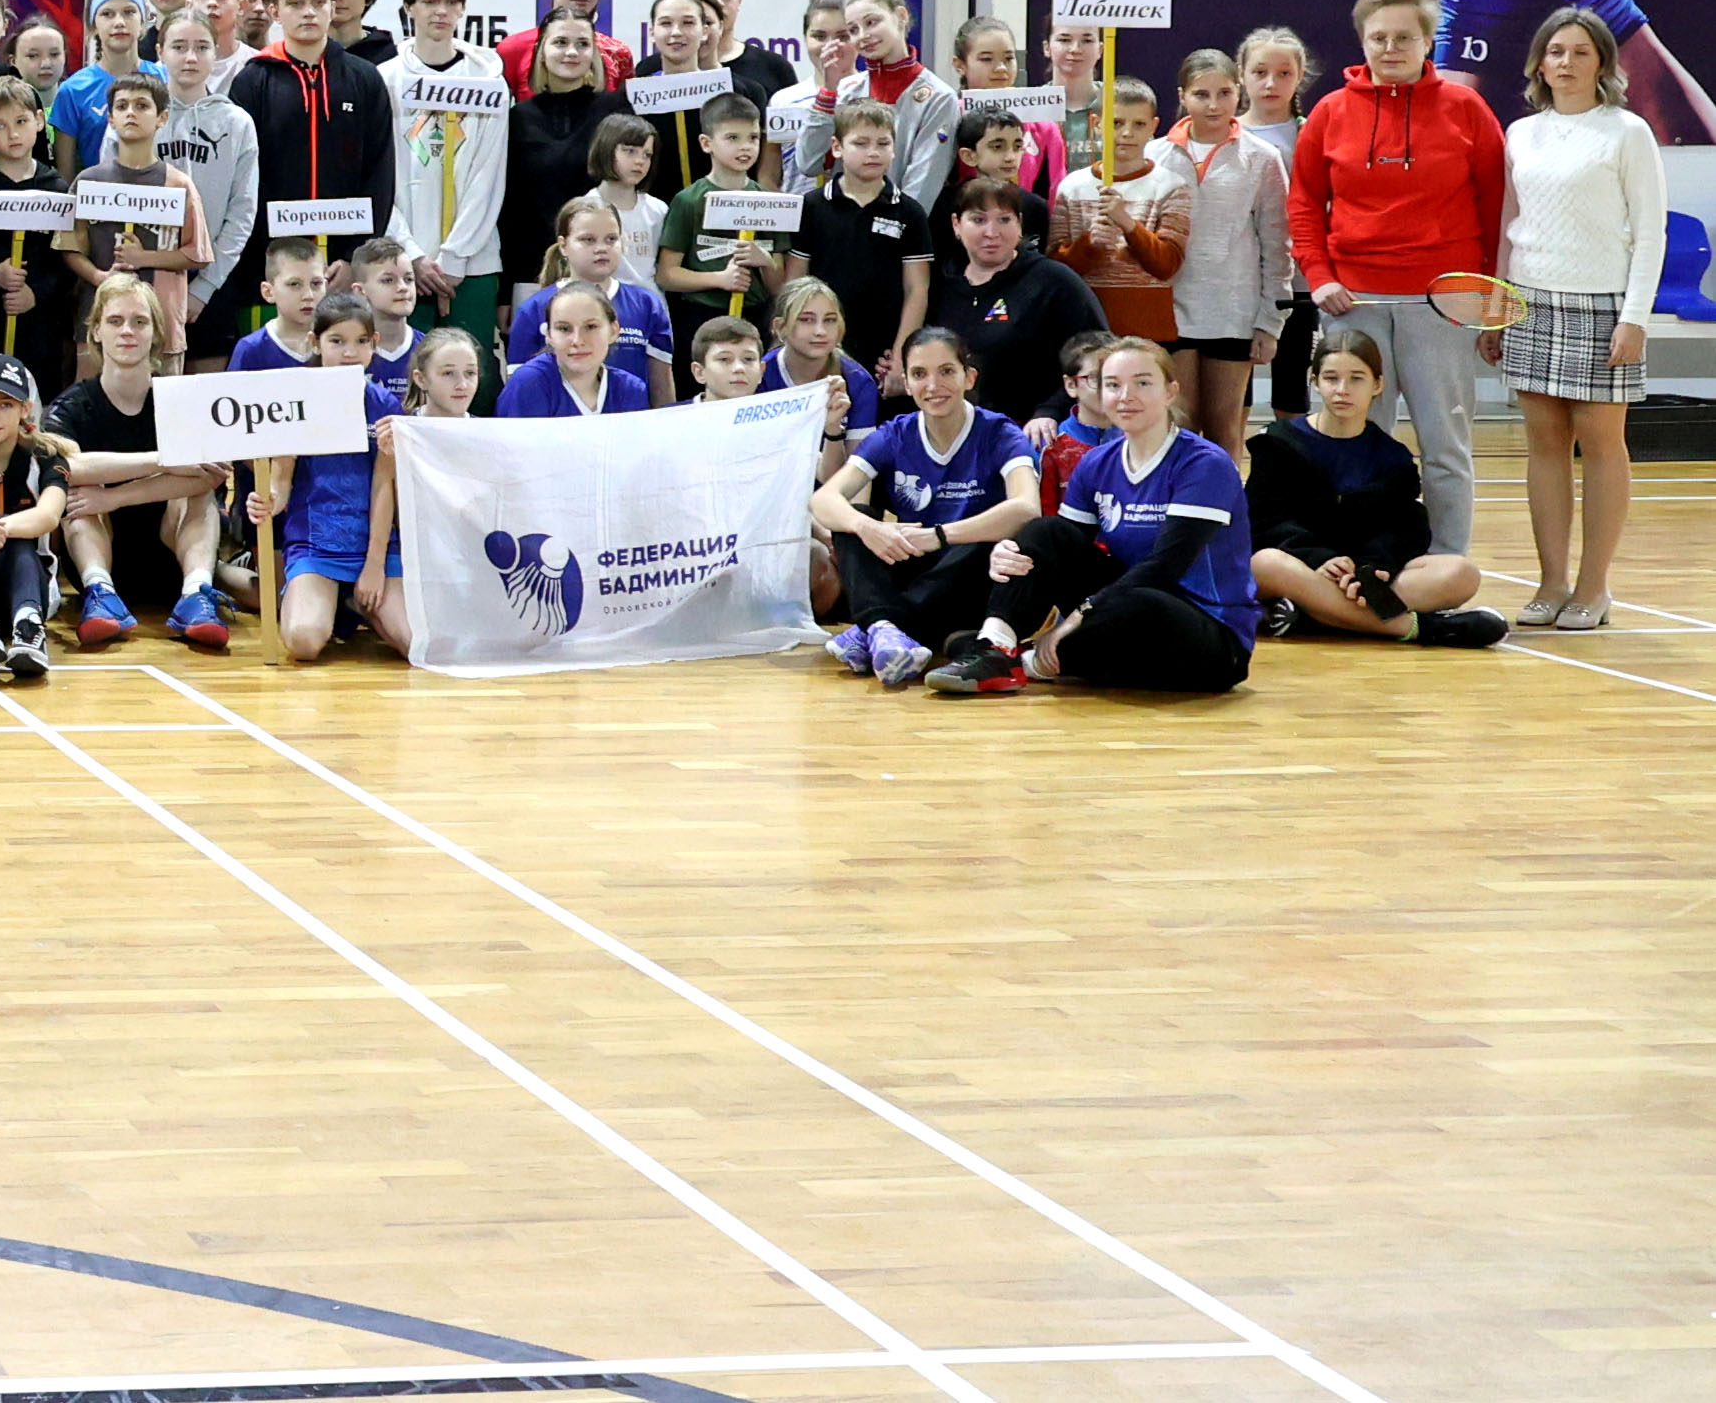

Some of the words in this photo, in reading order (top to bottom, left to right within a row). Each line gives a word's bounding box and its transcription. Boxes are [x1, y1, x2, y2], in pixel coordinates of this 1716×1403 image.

[402, 79, 504, 109] Анапа
[632, 80, 727, 109] Курганинск
[963, 94, 1064, 111] Воскресенск
[157, 139, 209, 165] PUMA
[79, 191, 179, 213] пгт.Сириус
[710, 196, 798, 211] Нижегородская
[276, 207, 367, 224] Кореновск
[733, 216, 777, 227] область
[210, 394, 308, 435] Орел
[733, 396, 813, 425] BARSSPORT
[597, 533, 739, 568] ФЕДЕРАЦИЯ
